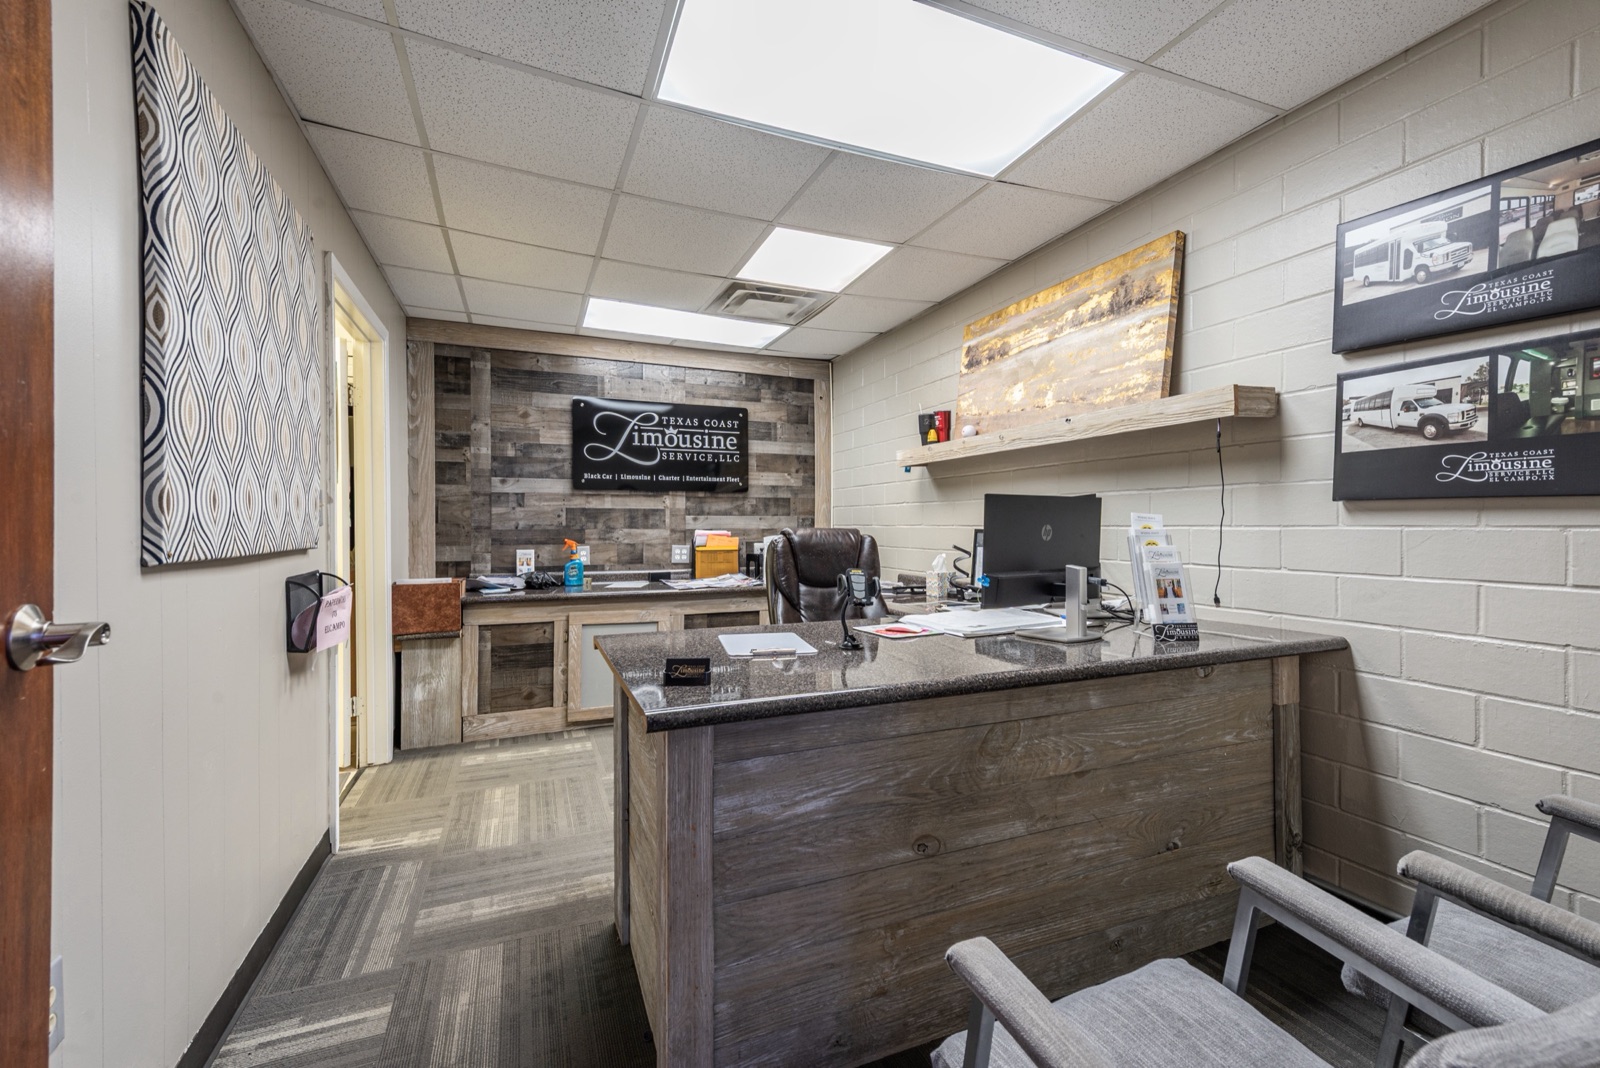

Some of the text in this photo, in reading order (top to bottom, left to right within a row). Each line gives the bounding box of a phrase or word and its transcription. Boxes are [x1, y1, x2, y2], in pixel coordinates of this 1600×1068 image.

[1488, 269, 1554, 289] TEXAS COAST
[1434, 279, 1551, 320] Limousine
[661, 416, 740, 429] TEXAS COAST
[583, 411, 738, 466] Limousine
[1489, 448, 1555, 459] TEXAS COAST
[1435, 451, 1552, 482] Limousine
[620, 473, 651, 481] Limousine
[686, 475, 725, 483] Entertainment
